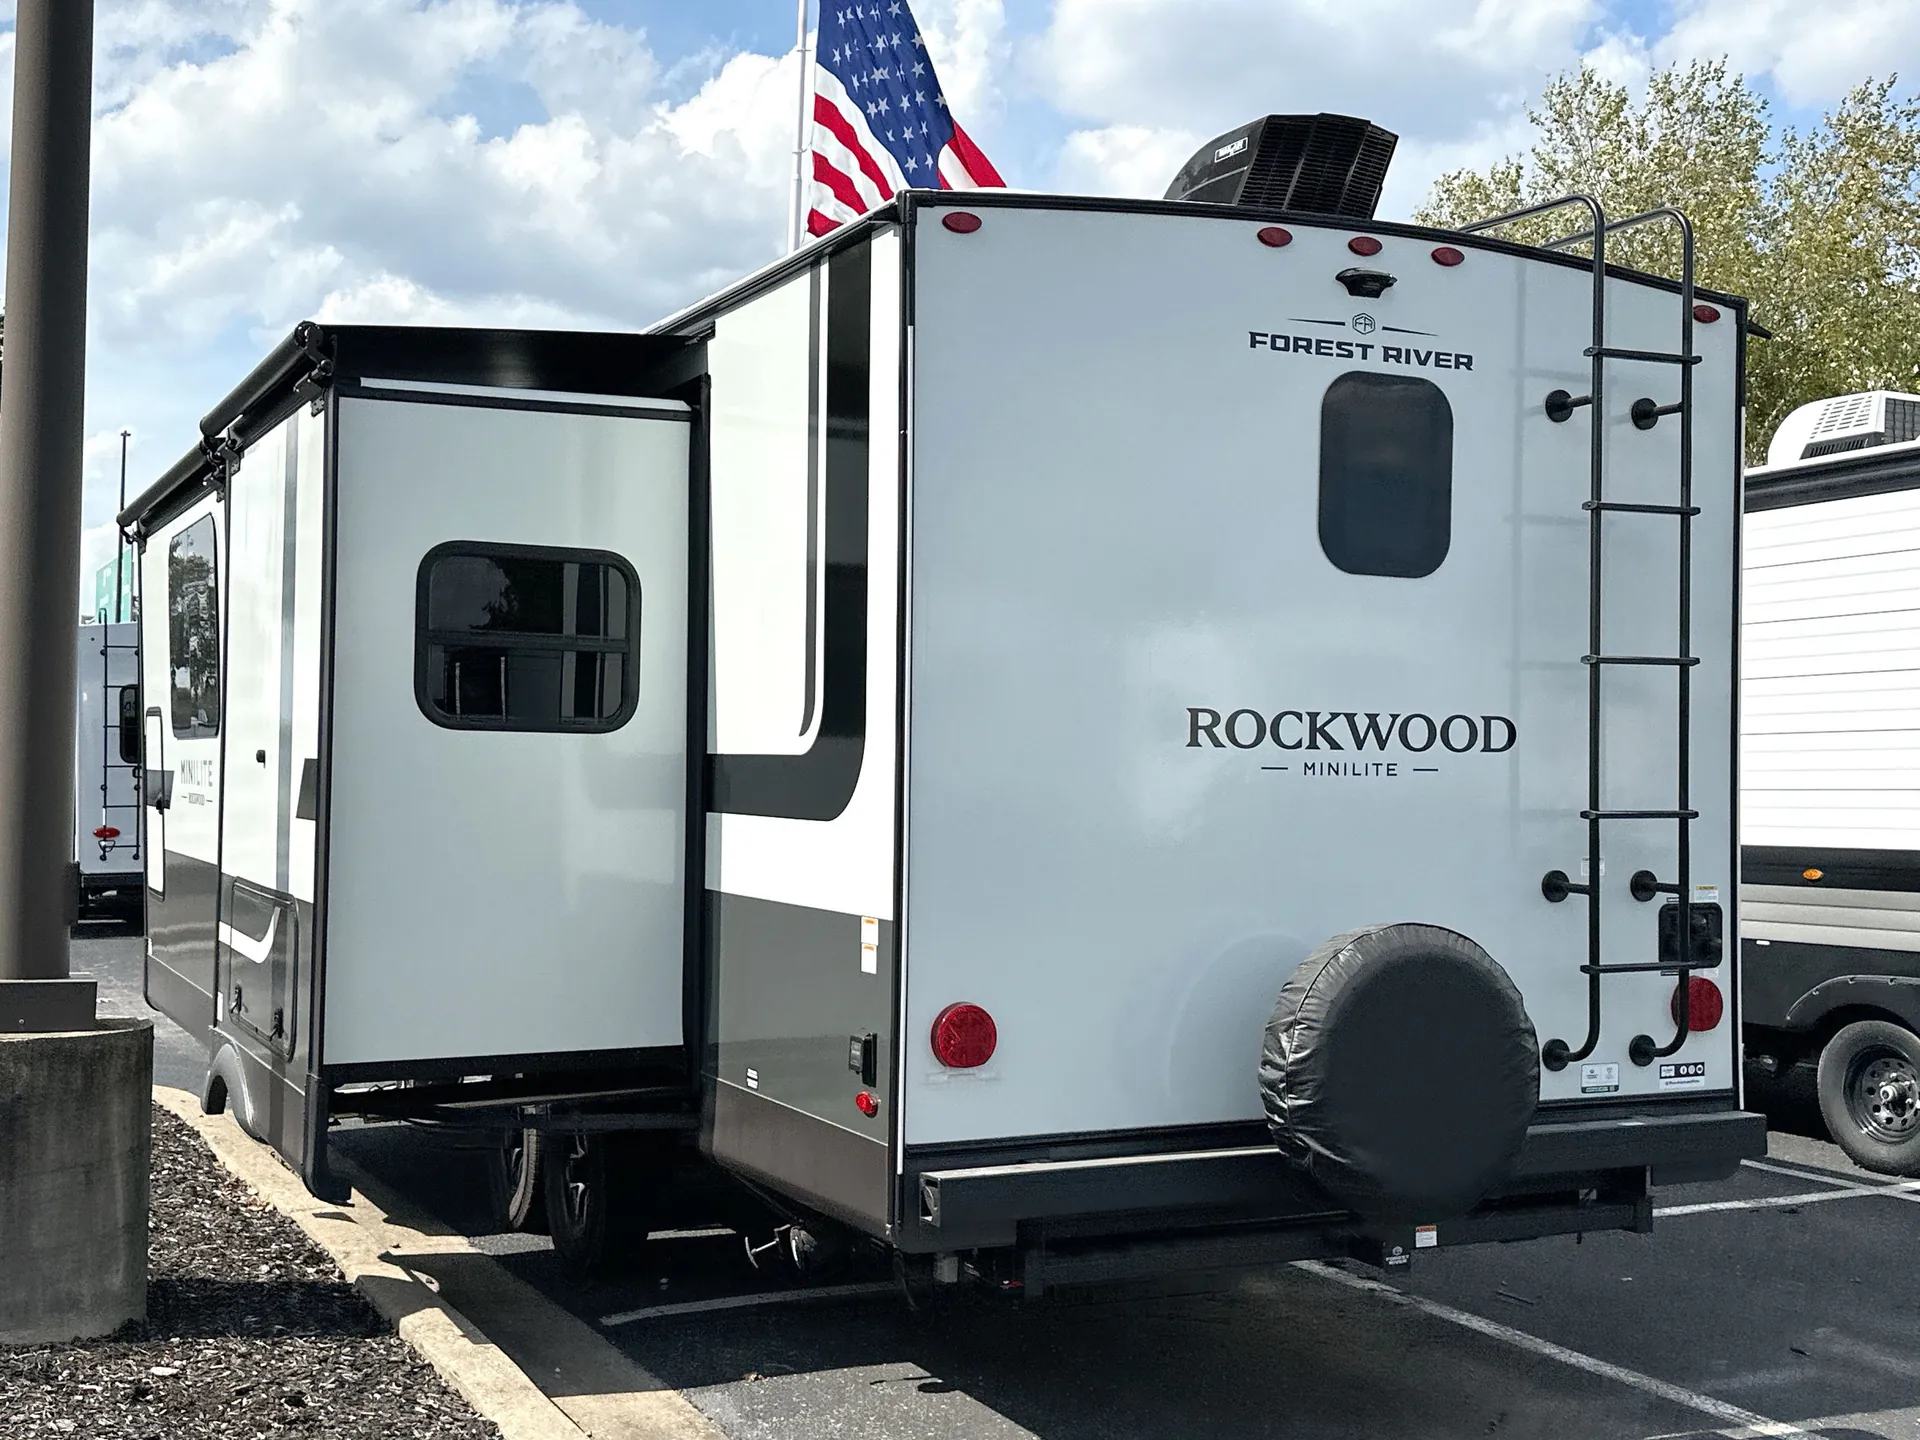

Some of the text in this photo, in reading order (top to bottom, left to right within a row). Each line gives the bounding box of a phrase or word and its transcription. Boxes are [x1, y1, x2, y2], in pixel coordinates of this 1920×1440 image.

[1249, 331, 1474, 371] FOREST RIVER
[1185, 707, 1517, 753] ROCKWOOD
[180, 759, 213, 787] MINILITE
[1303, 761, 1399, 777] MINILITE
